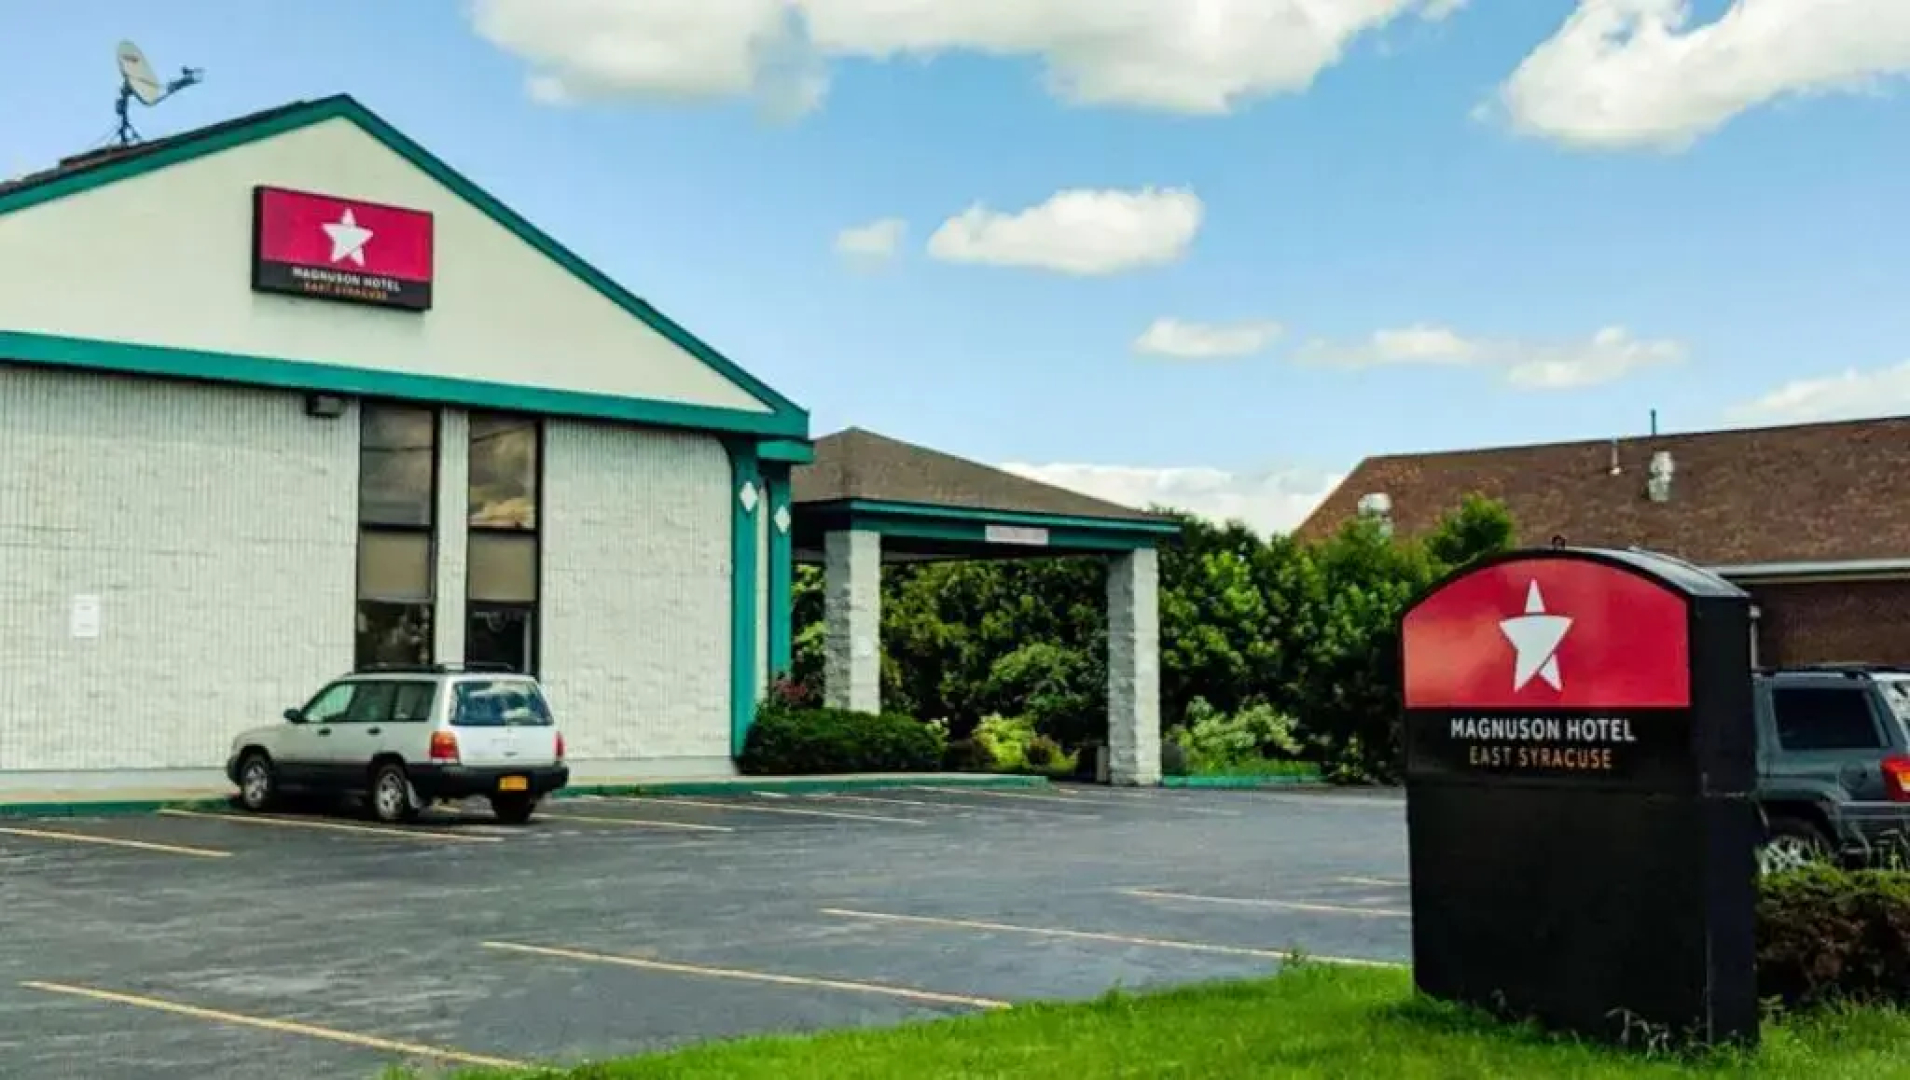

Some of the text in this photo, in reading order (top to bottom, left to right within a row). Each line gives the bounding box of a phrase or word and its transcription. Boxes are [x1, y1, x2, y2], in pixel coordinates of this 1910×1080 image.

[363, 277, 400, 292] HOTEL
[1450, 717, 1637, 742] MAGNUSON HOTEL
[1469, 745, 1612, 769] EAST SYRACUSE
